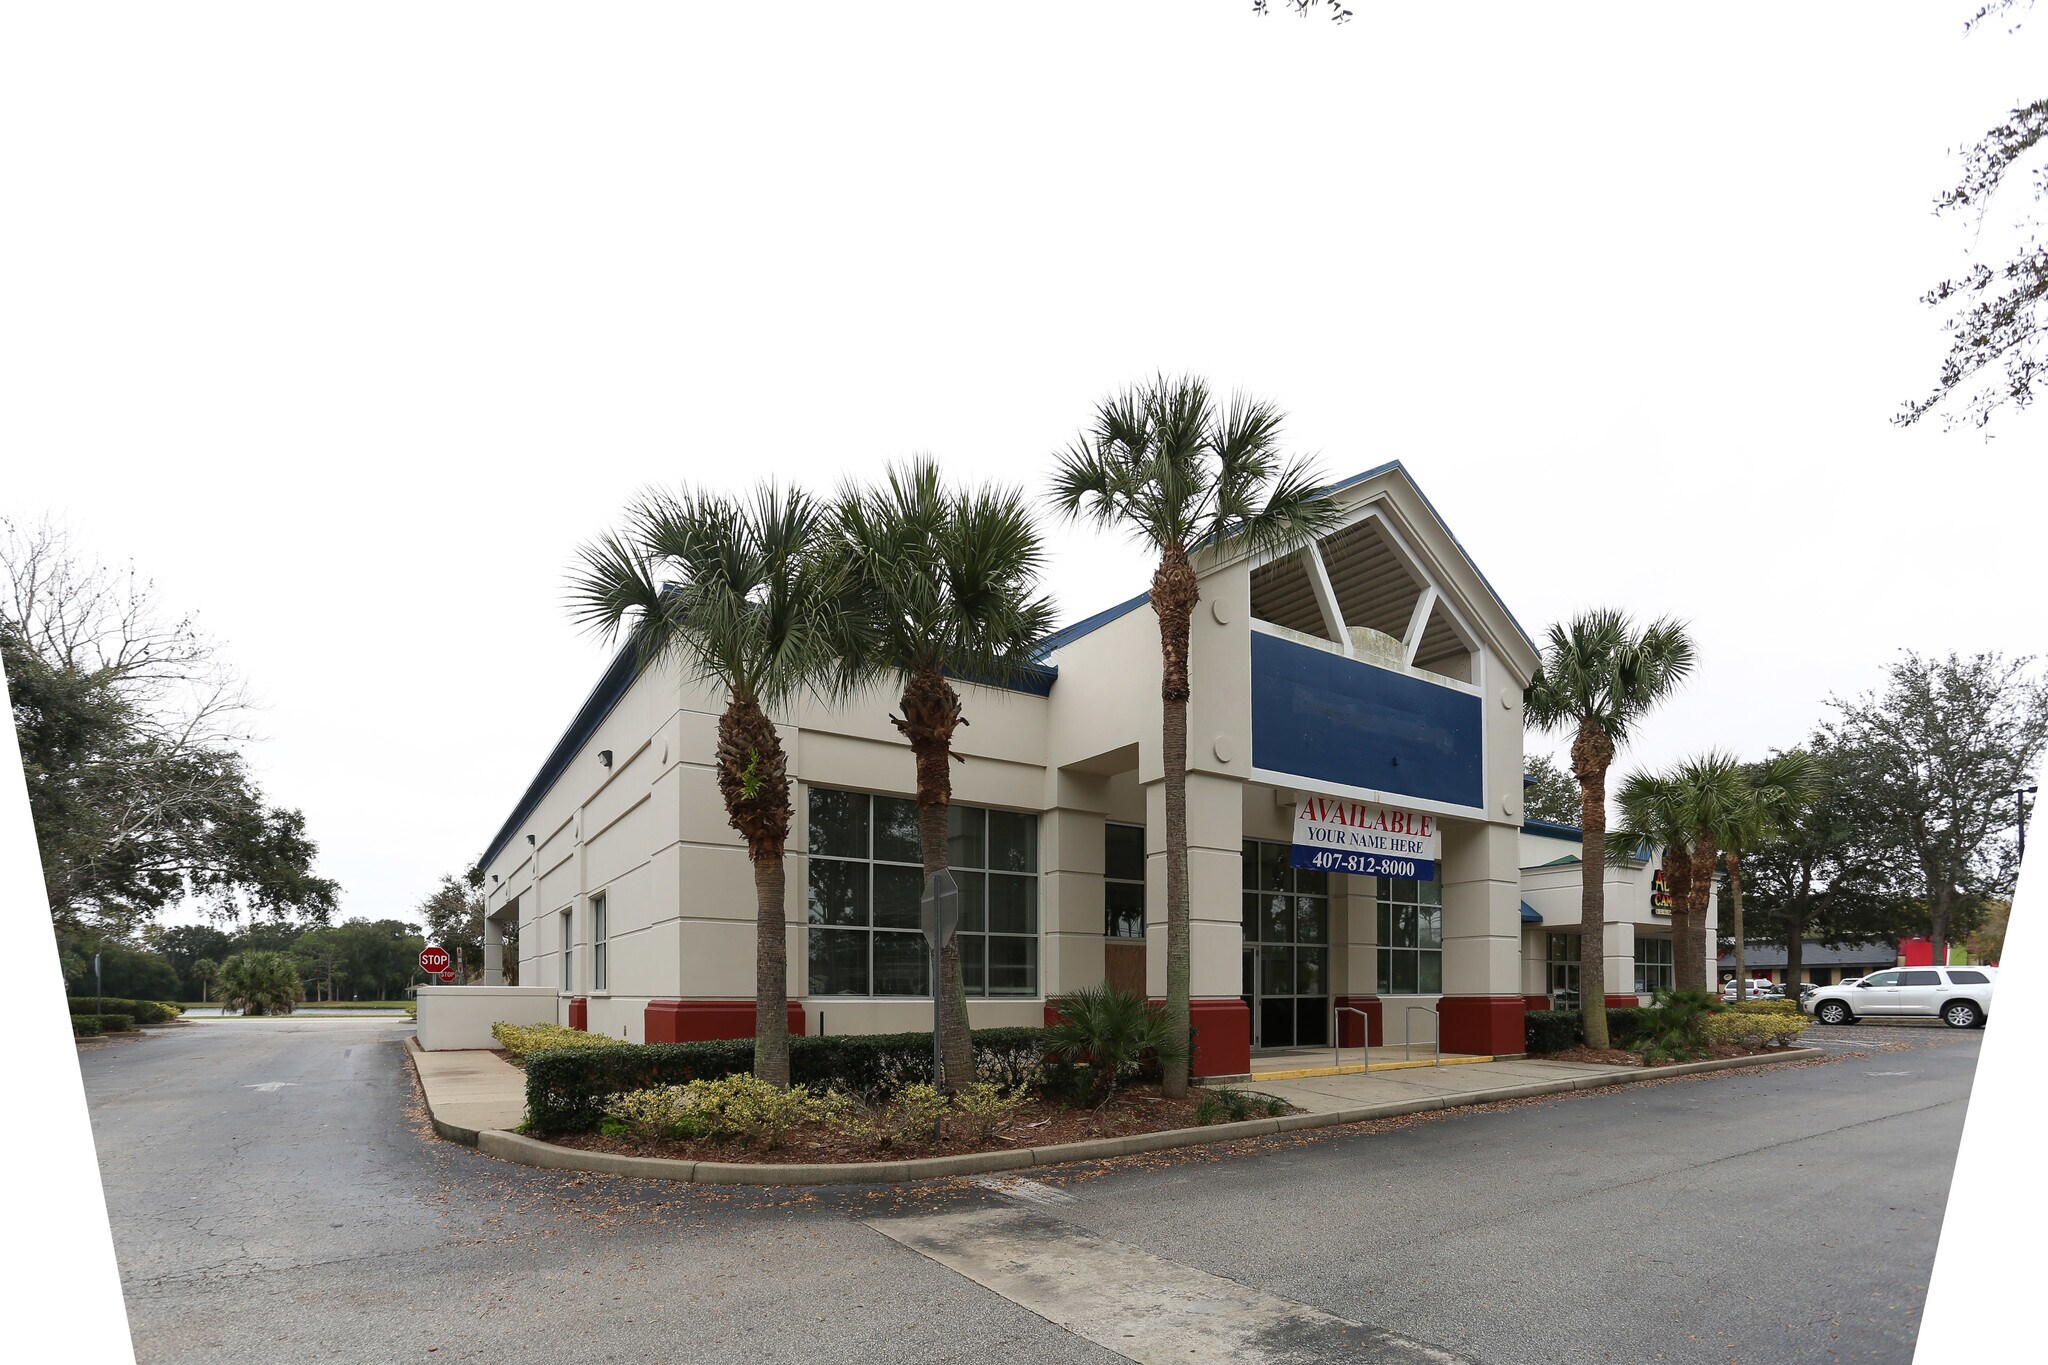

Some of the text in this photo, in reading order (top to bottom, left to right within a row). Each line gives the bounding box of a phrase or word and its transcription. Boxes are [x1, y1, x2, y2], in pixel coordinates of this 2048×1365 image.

[1300, 796, 1433, 838] AVAILABLE
[1307, 826, 1424, 854] YOUR NAME HERE
[1312, 851, 1415, 877] 407-812-8000
[422, 955, 448, 965] STOP
